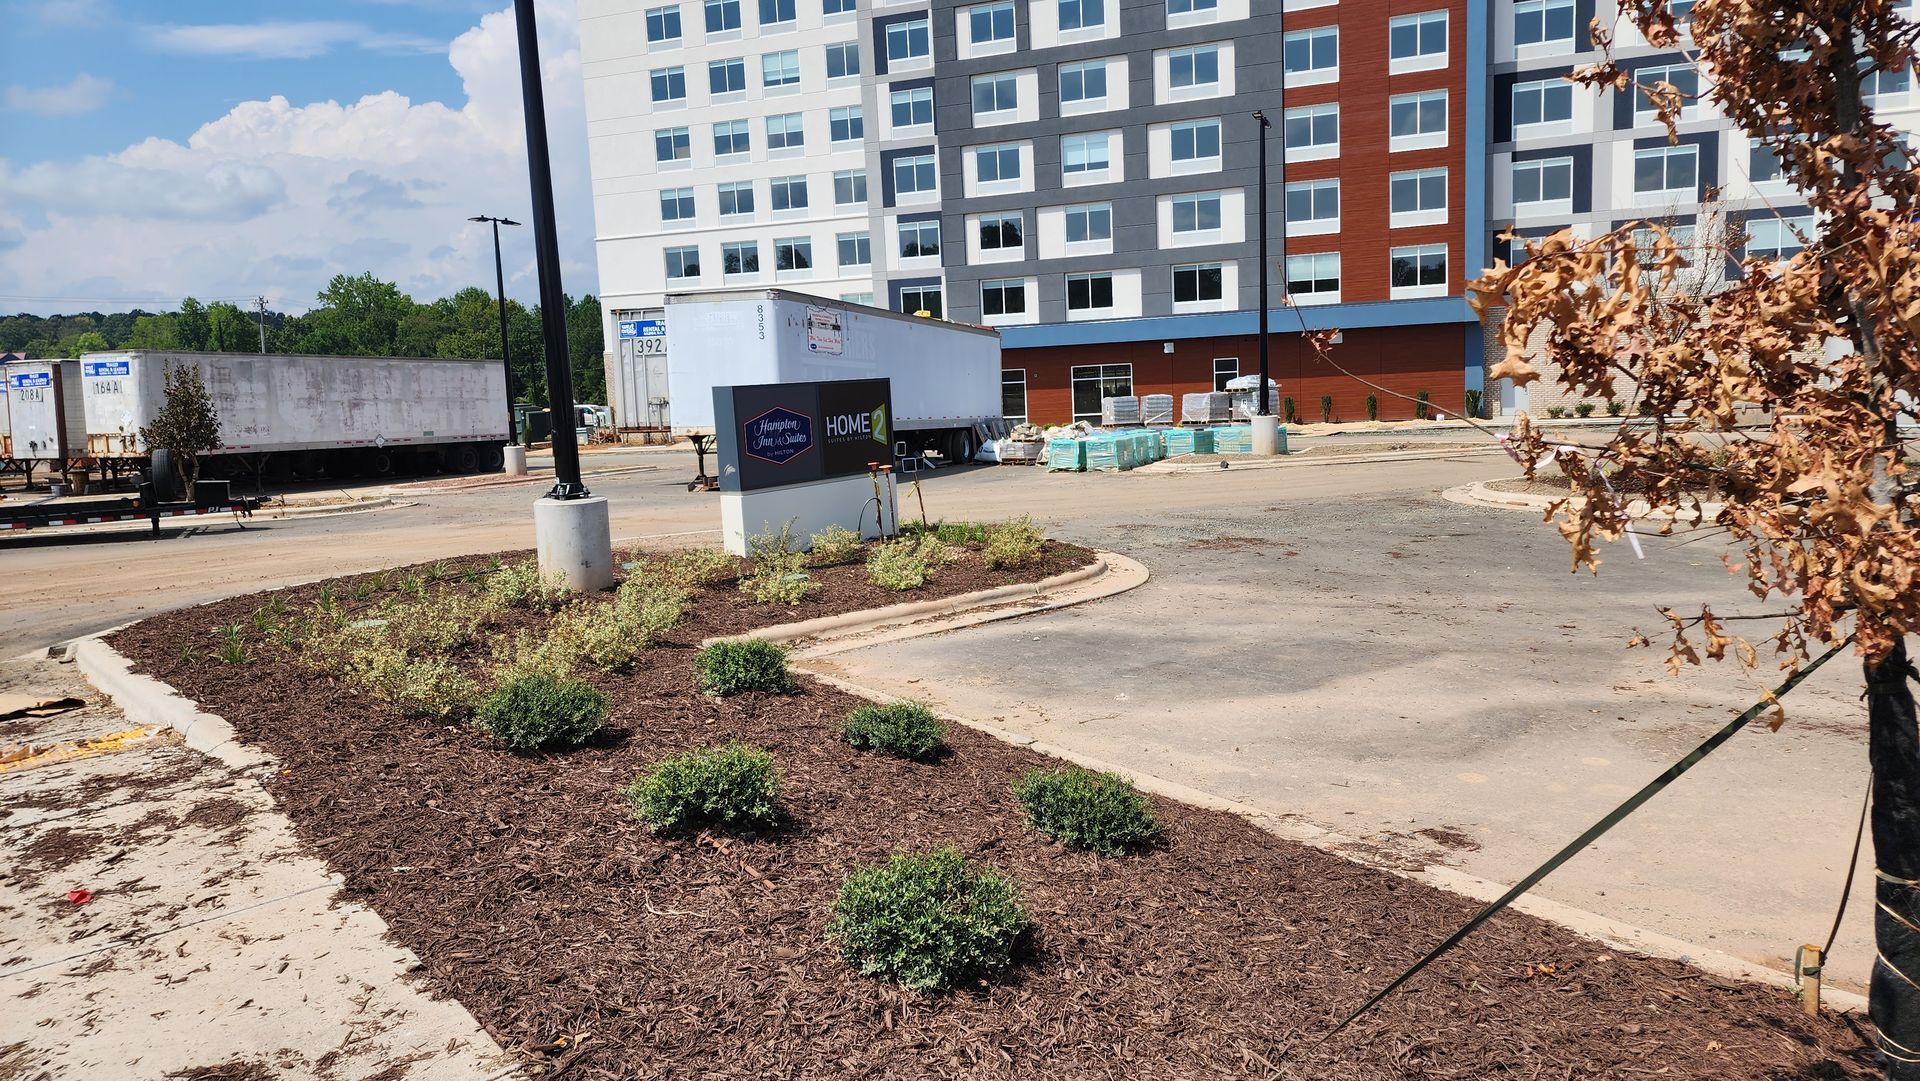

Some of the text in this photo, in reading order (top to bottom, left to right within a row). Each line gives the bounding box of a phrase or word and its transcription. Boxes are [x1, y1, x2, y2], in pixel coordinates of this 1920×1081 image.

[757, 304, 766, 341] 8353
[637, 338, 667, 353] 392
[20, 389, 40, 401] 208A
[753, 418, 800, 436] Hampton
[826, 409, 885, 441] HOME 2
[753, 435, 776, 450] Inn
[782, 432, 806, 445] Suites
